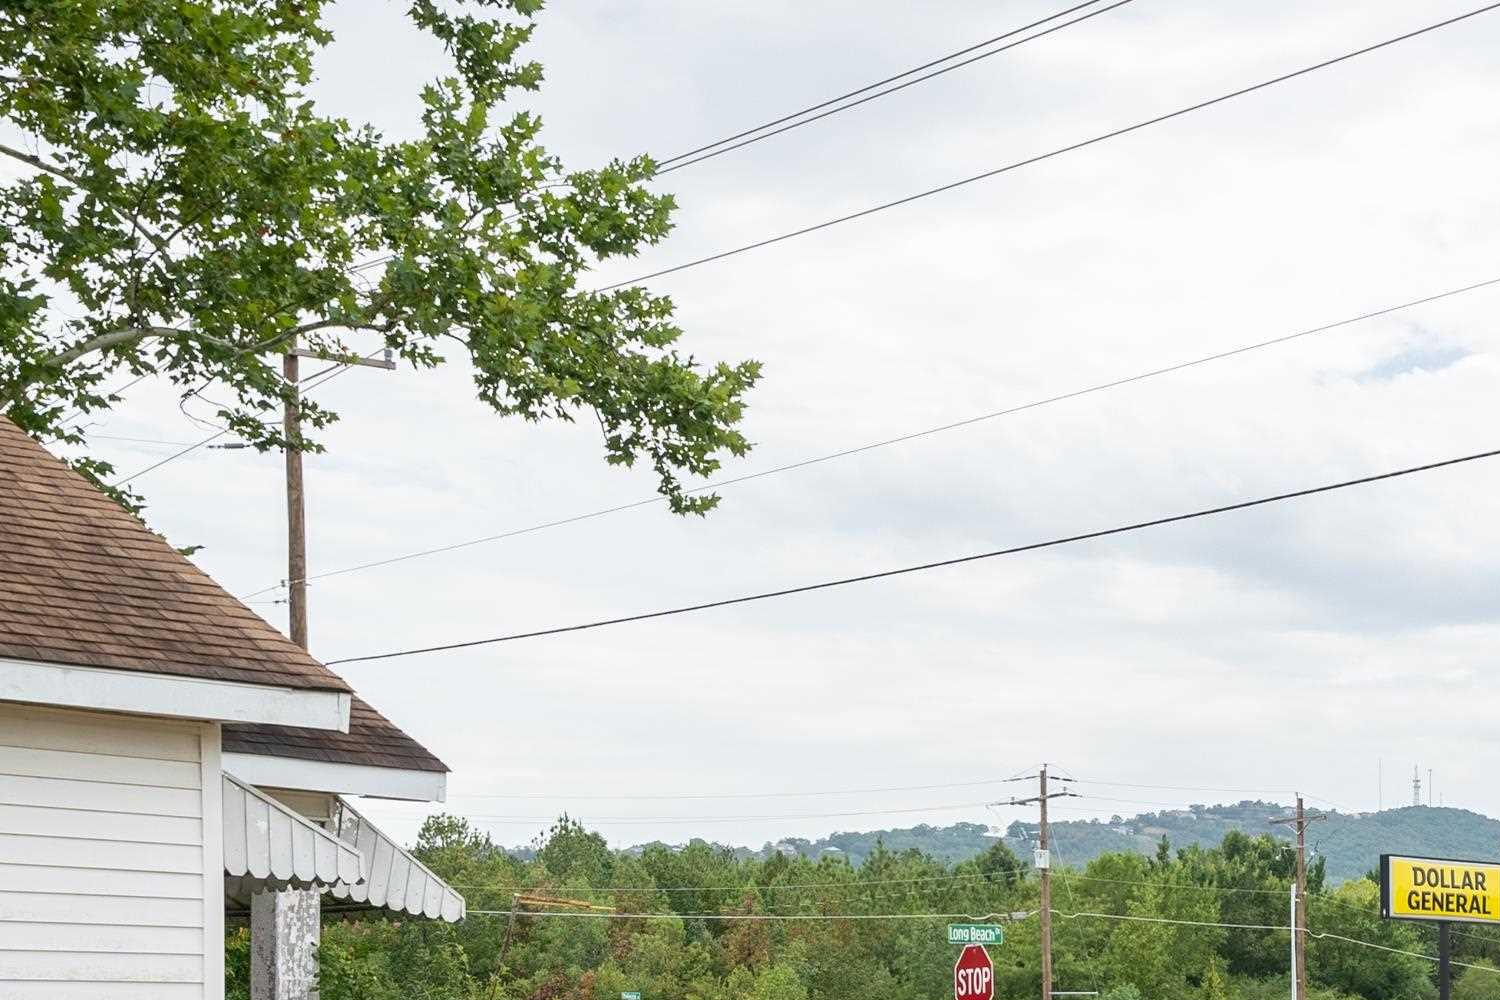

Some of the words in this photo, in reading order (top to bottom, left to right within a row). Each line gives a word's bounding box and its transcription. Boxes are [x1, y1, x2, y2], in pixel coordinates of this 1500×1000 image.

[1412, 866, 1486, 891] DOLLAR
[1407, 891, 1491, 915] GENERAL
[949, 926, 969, 941] Long
[970, 926, 995, 941] Beach
[957, 966, 991, 996] STOP
